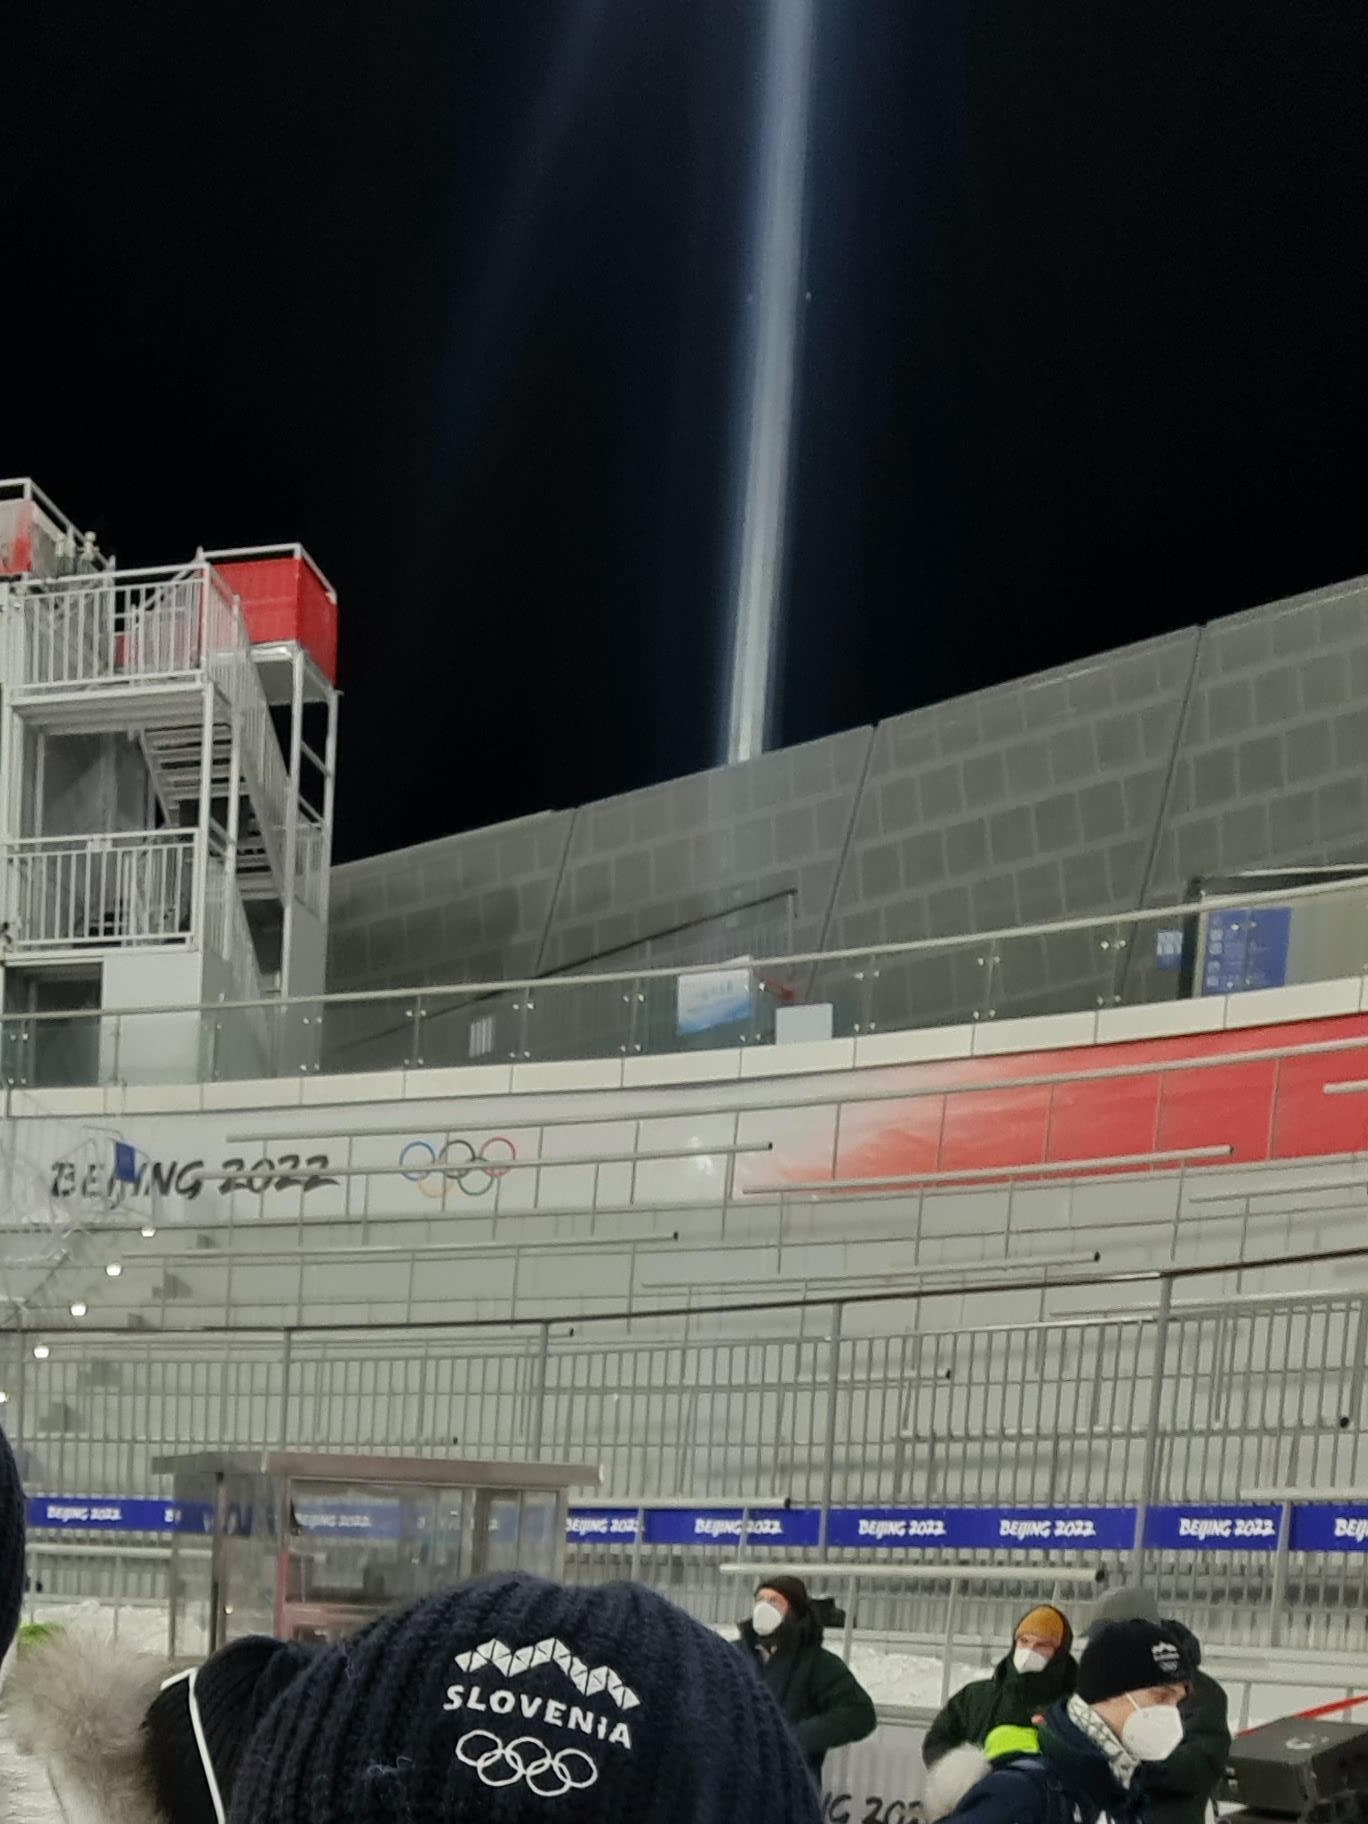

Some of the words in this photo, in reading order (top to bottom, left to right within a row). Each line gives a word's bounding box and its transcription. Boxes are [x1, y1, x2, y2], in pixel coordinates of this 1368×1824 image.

[218, 1154, 340, 1194] 2022
[47, 1505, 89, 1522] BEIJING
[90, 1507, 122, 1521] 2022
[695, 1518, 743, 1537] BEIJING
[859, 1518, 907, 1539] BEIJING
[909, 1520, 946, 1535] 2022
[999, 1518, 1051, 1540] BEIJING
[1054, 1520, 1096, 1537] 2022
[1179, 1518, 1232, 1540] BEIJING
[1234, 1519, 1275, 1537] 2022
[443, 1684, 631, 1750] SLOVENIA
